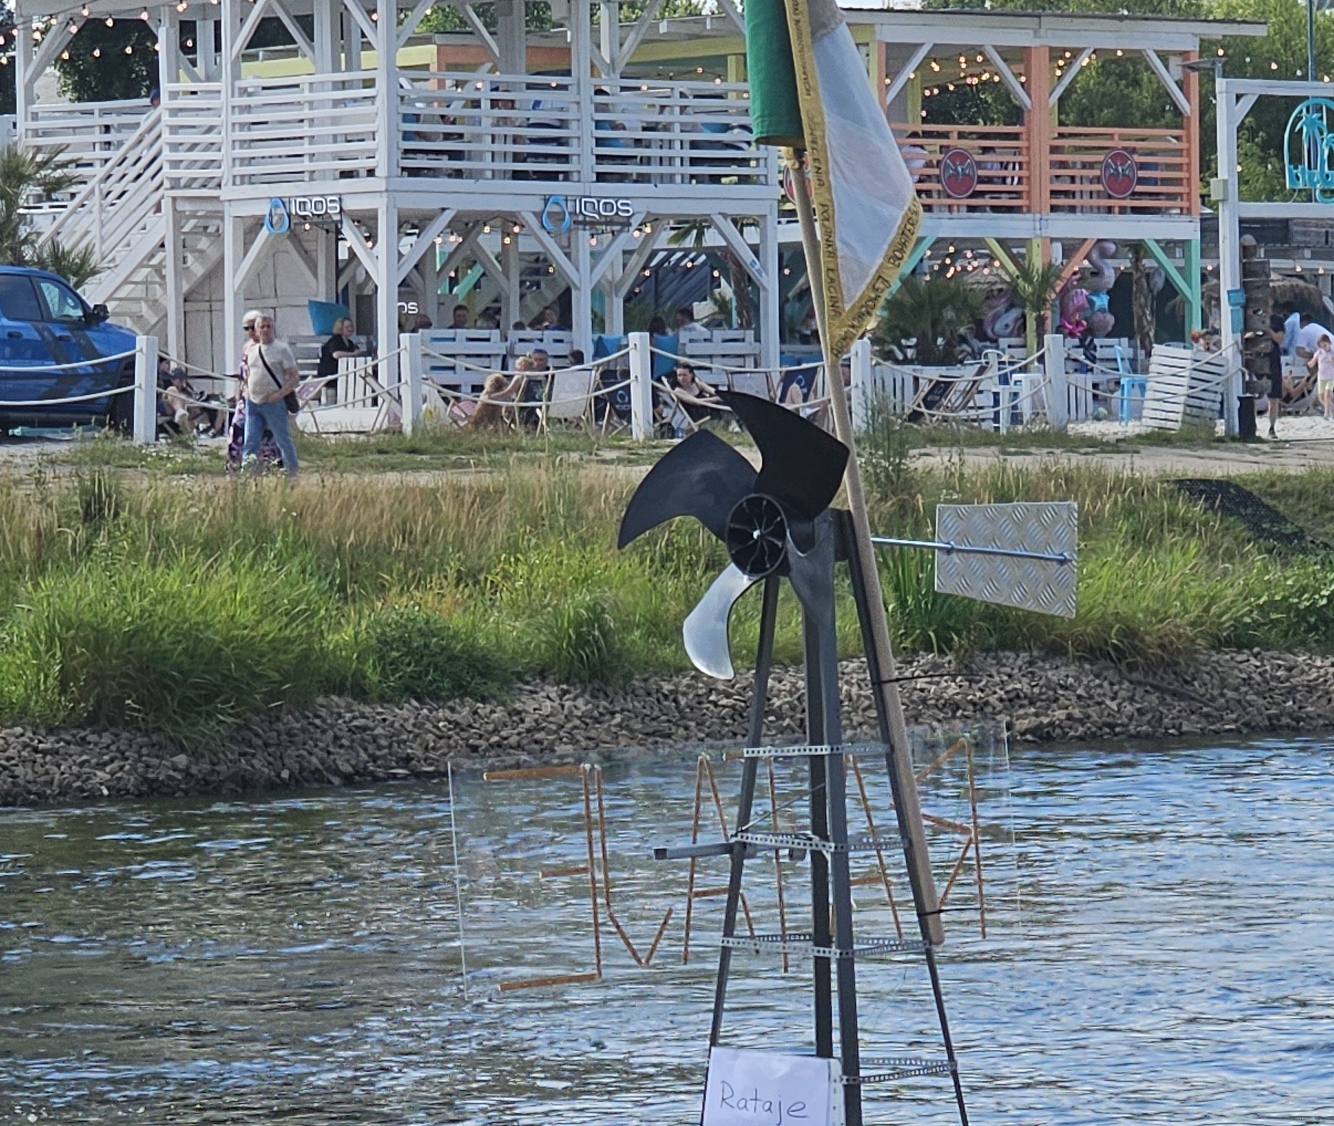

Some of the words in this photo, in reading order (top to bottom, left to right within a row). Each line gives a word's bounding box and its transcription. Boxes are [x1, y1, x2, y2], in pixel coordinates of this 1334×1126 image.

[291, 195, 341, 217] IQOS
[576, 197, 634, 220] IQOS
[719, 1080, 809, 1126] Rataje
